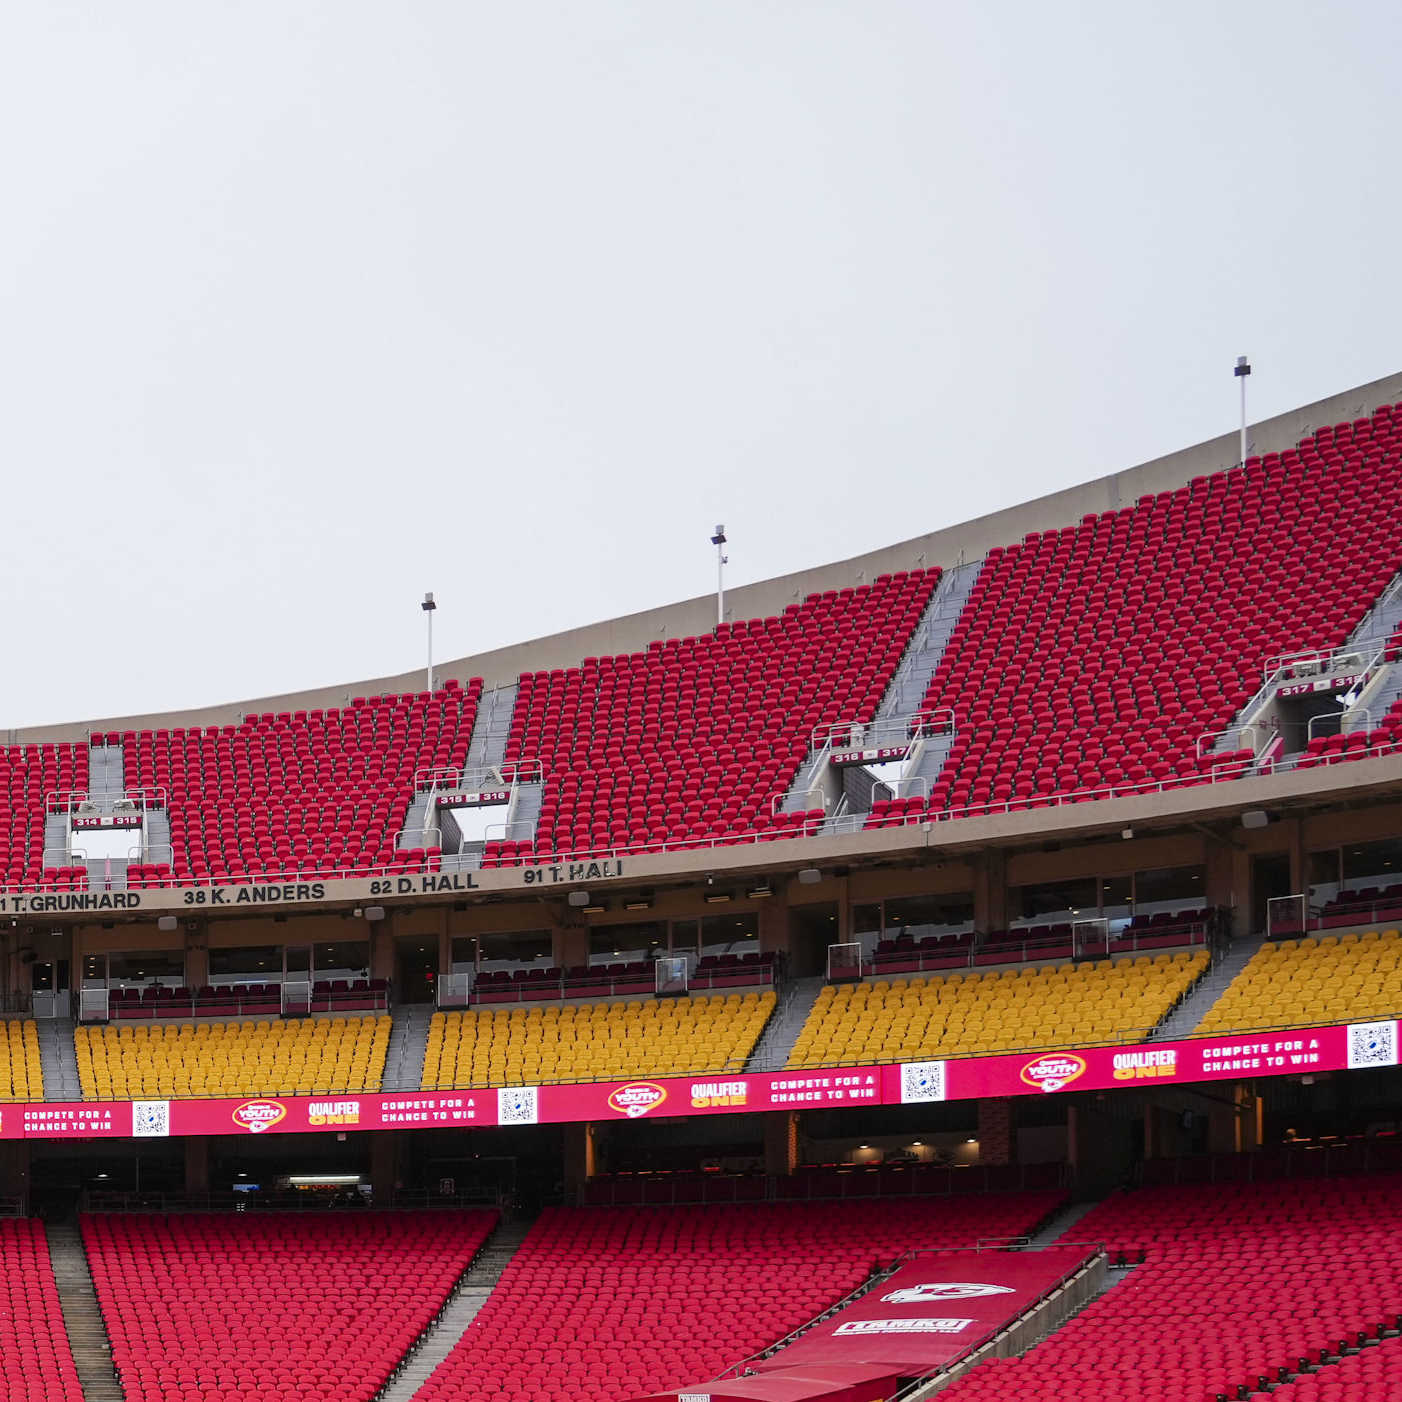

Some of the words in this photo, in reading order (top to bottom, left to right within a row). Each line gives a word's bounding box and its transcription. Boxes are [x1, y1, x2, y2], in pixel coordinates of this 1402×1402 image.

[835, 754, 858, 762] 316
[883, 748, 906, 756] 317
[441, 795, 462, 804] 315
[483, 792, 506, 801] 316
[76, 818, 97, 826] 314
[116, 817, 137, 825] 315
[524, 869, 542, 883] 91
[549, 867, 563, 882] T.
[570, 860, 622, 880] HALI
[371, 881, 392, 894] 82
[398, 878, 416, 893] D.
[423, 874, 479, 892] HALL
[184, 891, 205, 904] 38
[212, 889, 230, 904] K.
[236, 884, 324, 903] ANDERS
[11, 897, 27, 911] T.
[30, 893, 140, 911] GRUNHARD
[1202, 1043, 1269, 1059] COMPETE
[1274, 1040, 1303, 1052] FOR
[1309, 1039, 1319, 1049] A
[1113, 1050, 1176, 1070] QUALIFIER
[1202, 1058, 1260, 1072] CHANCE
[1266, 1056, 1285, 1067] TO
[1290, 1053, 1319, 1065] WIN
[1029, 1064, 1077, 1073] YOUTH
[1115, 1064, 1175, 1079] ONE
[691, 1081, 747, 1098] QUALIFIER
[770, 1078, 830, 1091] COMPETE
[834, 1076, 861, 1087] FOR
[865, 1075, 875, 1085] A
[616, 1091, 659, 1100] YOUTH
[691, 1096, 747, 1108] ONE
[770, 1091, 822, 1103] CHANCE
[826, 1090, 844, 1100] TO
[848, 1088, 875, 1099] WIN
[309, 1101, 359, 1116] QUALIFIER
[381, 1100, 435, 1111] COMPETE
[439, 1098, 463, 1109] FOR
[467, 1098, 475, 1107] A
[239, 1109, 278, 1117] YOUTH
[309, 1114, 359, 1126] ONE
[381, 1112, 428, 1122] CHANCE
[432, 1111, 448, 1121] TO
[452, 1110, 475, 1120] WIN
[680, 1395, 708, 1402] TAMKO
